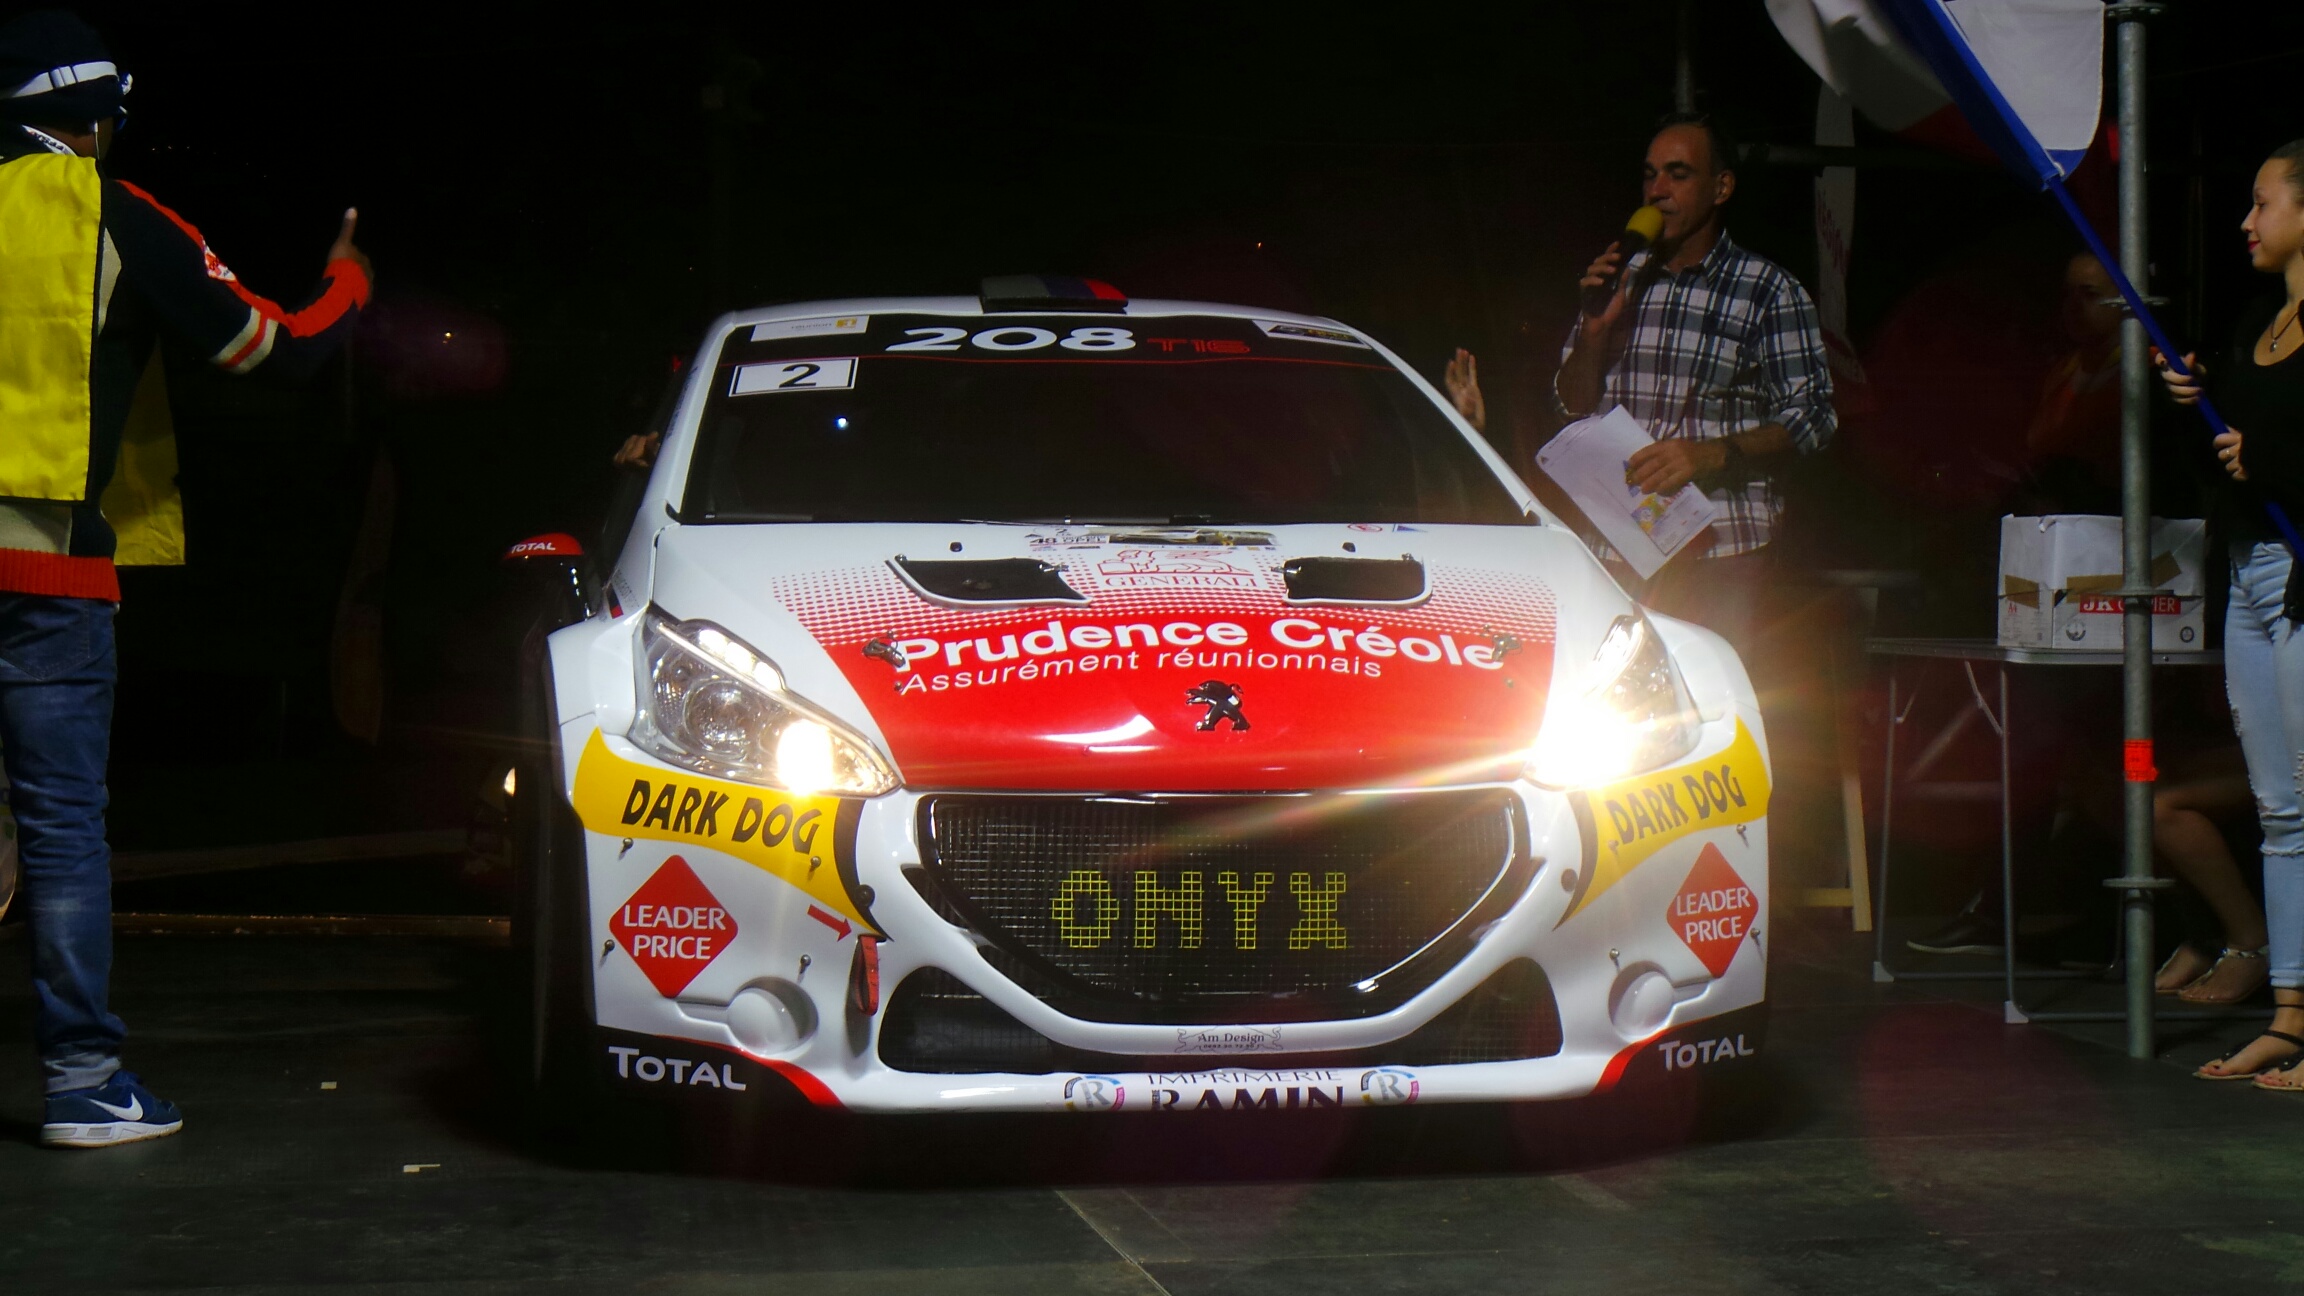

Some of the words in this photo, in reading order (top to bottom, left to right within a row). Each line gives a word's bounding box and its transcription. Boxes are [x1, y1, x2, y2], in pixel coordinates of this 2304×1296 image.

[885, 327, 1136, 350] 208
[779, 363, 821, 388] 2
[511, 542, 556, 554] TOTAL
[1104, 574, 1259, 589] GENERALI
[2083, 600, 2113, 611] JK
[895, 621, 1248, 672] Prudence
[1270, 619, 1504, 670] Créole
[901, 650, 1140, 695] Assurément
[1158, 648, 1382, 678] réunionnais
[621, 778, 729, 838] DARK
[732, 797, 822, 855] DOG
[1605, 782, 1689, 845] DARK
[1682, 764, 1747, 820] DOG
[1675, 887, 1751, 917] LEADER
[623, 904, 726, 931] LEADER
[1685, 916, 1743, 944] PRICE
[633, 934, 712, 960] PRICE
[1198, 1033, 1218, 1042] Am
[1224, 1032, 1265, 1045] Design
[1659, 1034, 1754, 1071] TOTAL
[608, 1046, 746, 1091] TOTAL
[1147, 1069, 1342, 1086] IMPRIMERIE
[1151, 1086, 1344, 1110] RAMIN
